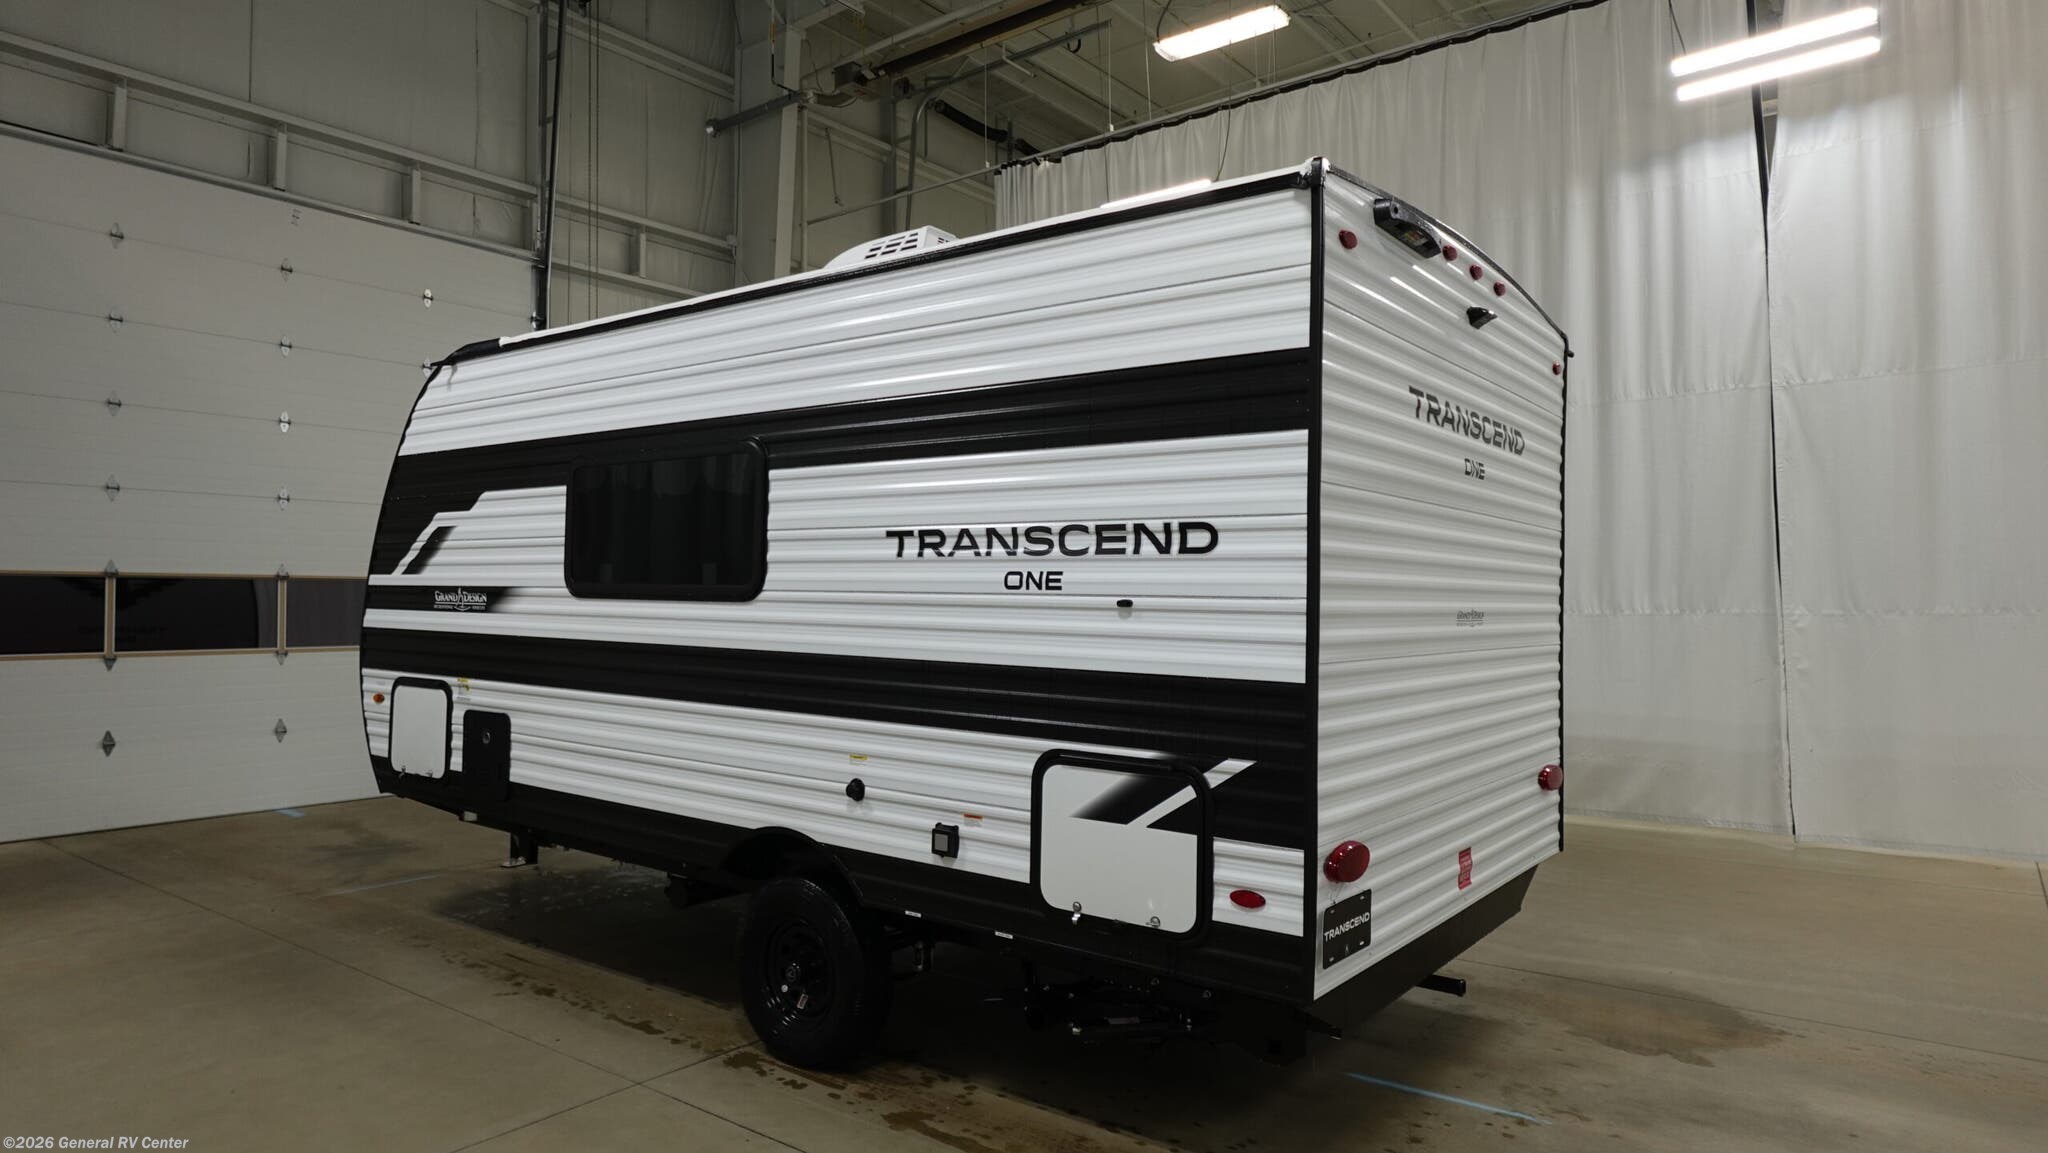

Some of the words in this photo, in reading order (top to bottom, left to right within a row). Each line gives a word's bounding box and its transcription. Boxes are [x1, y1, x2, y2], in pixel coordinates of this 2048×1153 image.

[1408, 385, 1525, 456] TRANSCEND
[1464, 458, 1485, 480] ONE
[886, 521, 1219, 558] TRANSCEND
[1004, 571, 1063, 590] ONE
[1324, 911, 1370, 942] TRANSCEND
